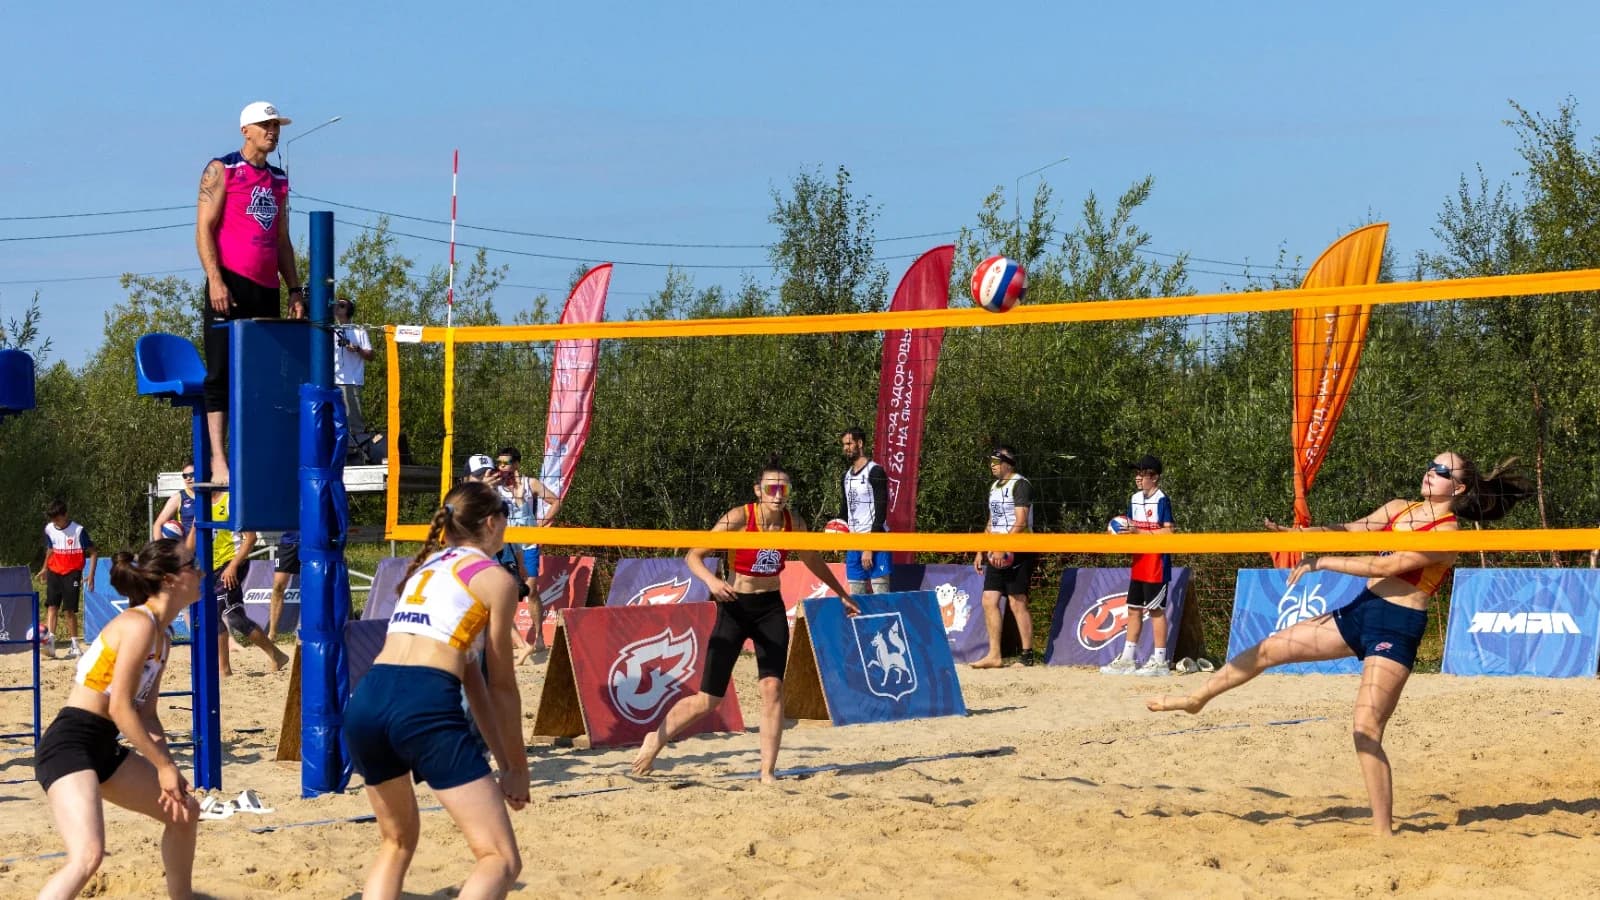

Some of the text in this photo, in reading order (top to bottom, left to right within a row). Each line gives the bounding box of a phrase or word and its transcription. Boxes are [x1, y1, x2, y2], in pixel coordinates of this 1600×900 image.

[896, 425, 909, 447] НА
[218, 505, 226, 516] 2
[405, 569, 435, 605] 1
[1467, 612, 1582, 634] ЯМАЛ
